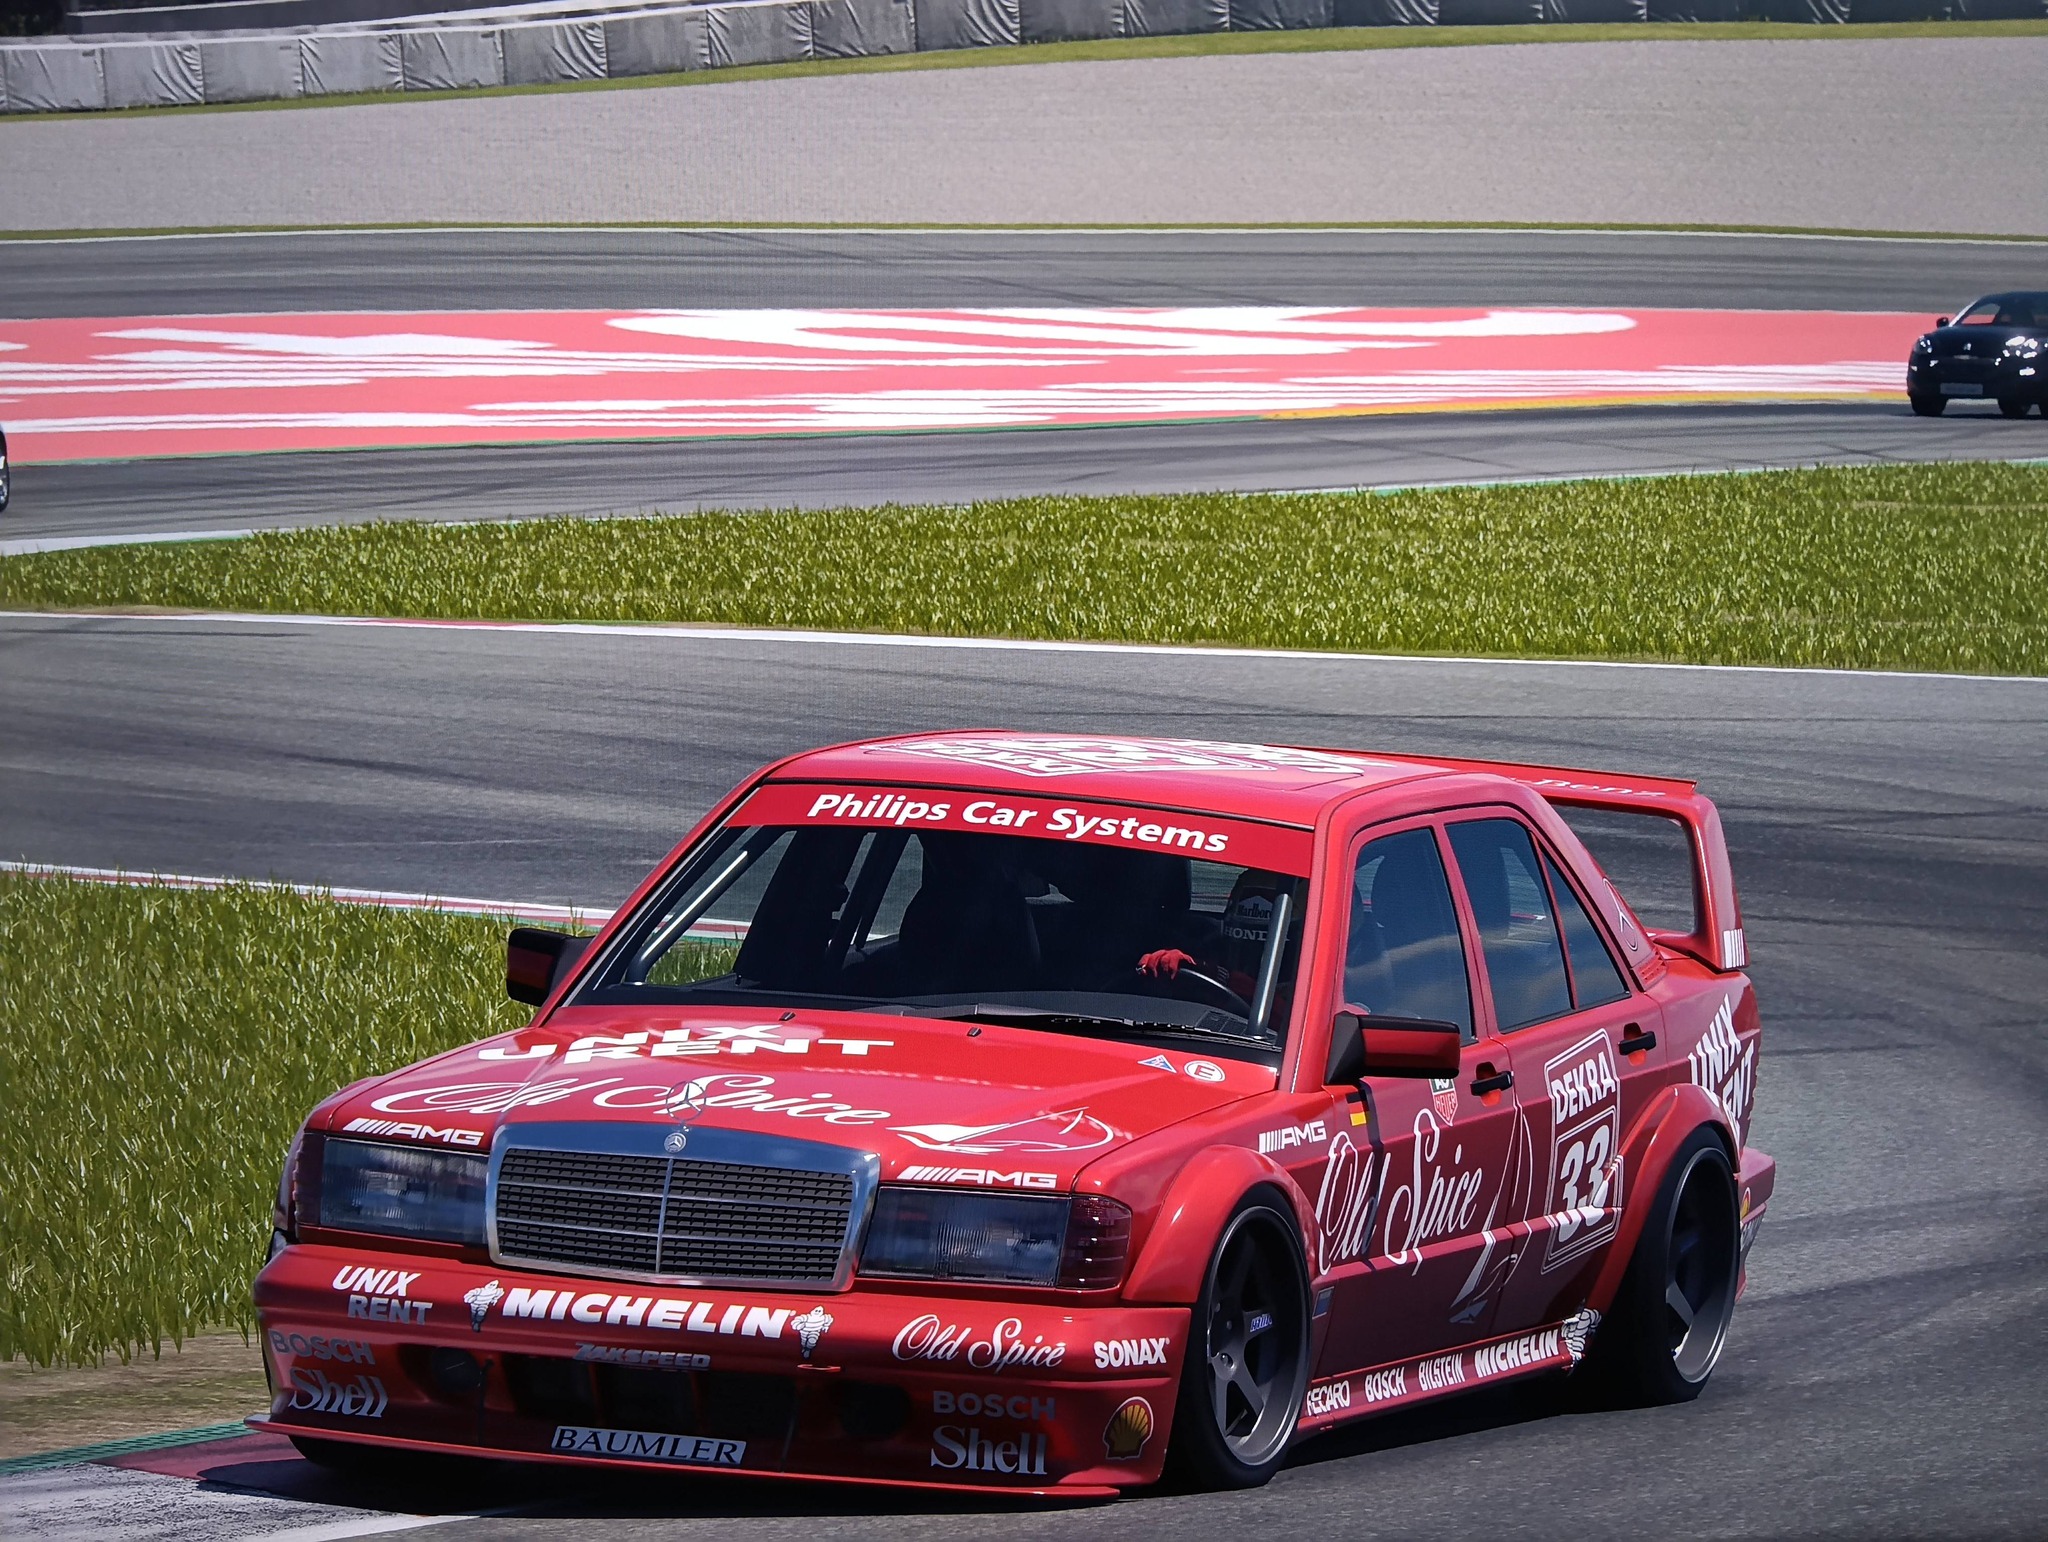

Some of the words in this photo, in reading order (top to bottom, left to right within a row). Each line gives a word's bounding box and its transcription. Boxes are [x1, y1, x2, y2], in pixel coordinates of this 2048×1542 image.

[807, 793, 951, 826] Philips
[962, 800, 1037, 829] Car
[1046, 808, 1229, 853] Systems
[1238, 903, 1273, 919] Marlbor
[477, 1024, 782, 1060] UNIX
[563, 1038, 895, 1065] RENT
[1550, 1051, 1616, 1125] DEKRA
[1281, 1120, 1326, 1148] AMG
[953, 1169, 1057, 1188] AMG
[1315, 1131, 1391, 1276] Old
[1384, 1108, 1482, 1276] Spice
[1555, 1124, 1612, 1243] 33
[332, 1266, 421, 1297] UNIX
[347, 1294, 433, 1326] RENT
[503, 1287, 791, 1340] MICHELIN
[268, 1327, 376, 1366] BOSCH
[573, 1342, 711, 1368] ZAKSPEED
[891, 1314, 970, 1363] Old
[967, 1317, 1067, 1374] Spice
[1094, 1338, 1166, 1369] SONAX
[1364, 1366, 1407, 1403] BOSCH
[1418, 1353, 1466, 1391] BILSTEIN
[1474, 1328, 1560, 1378] MICHELIN
[288, 1366, 389, 1418] Shell
[933, 1391, 1055, 1421] BOSCH
[930, 1425, 1048, 1475] Shell
